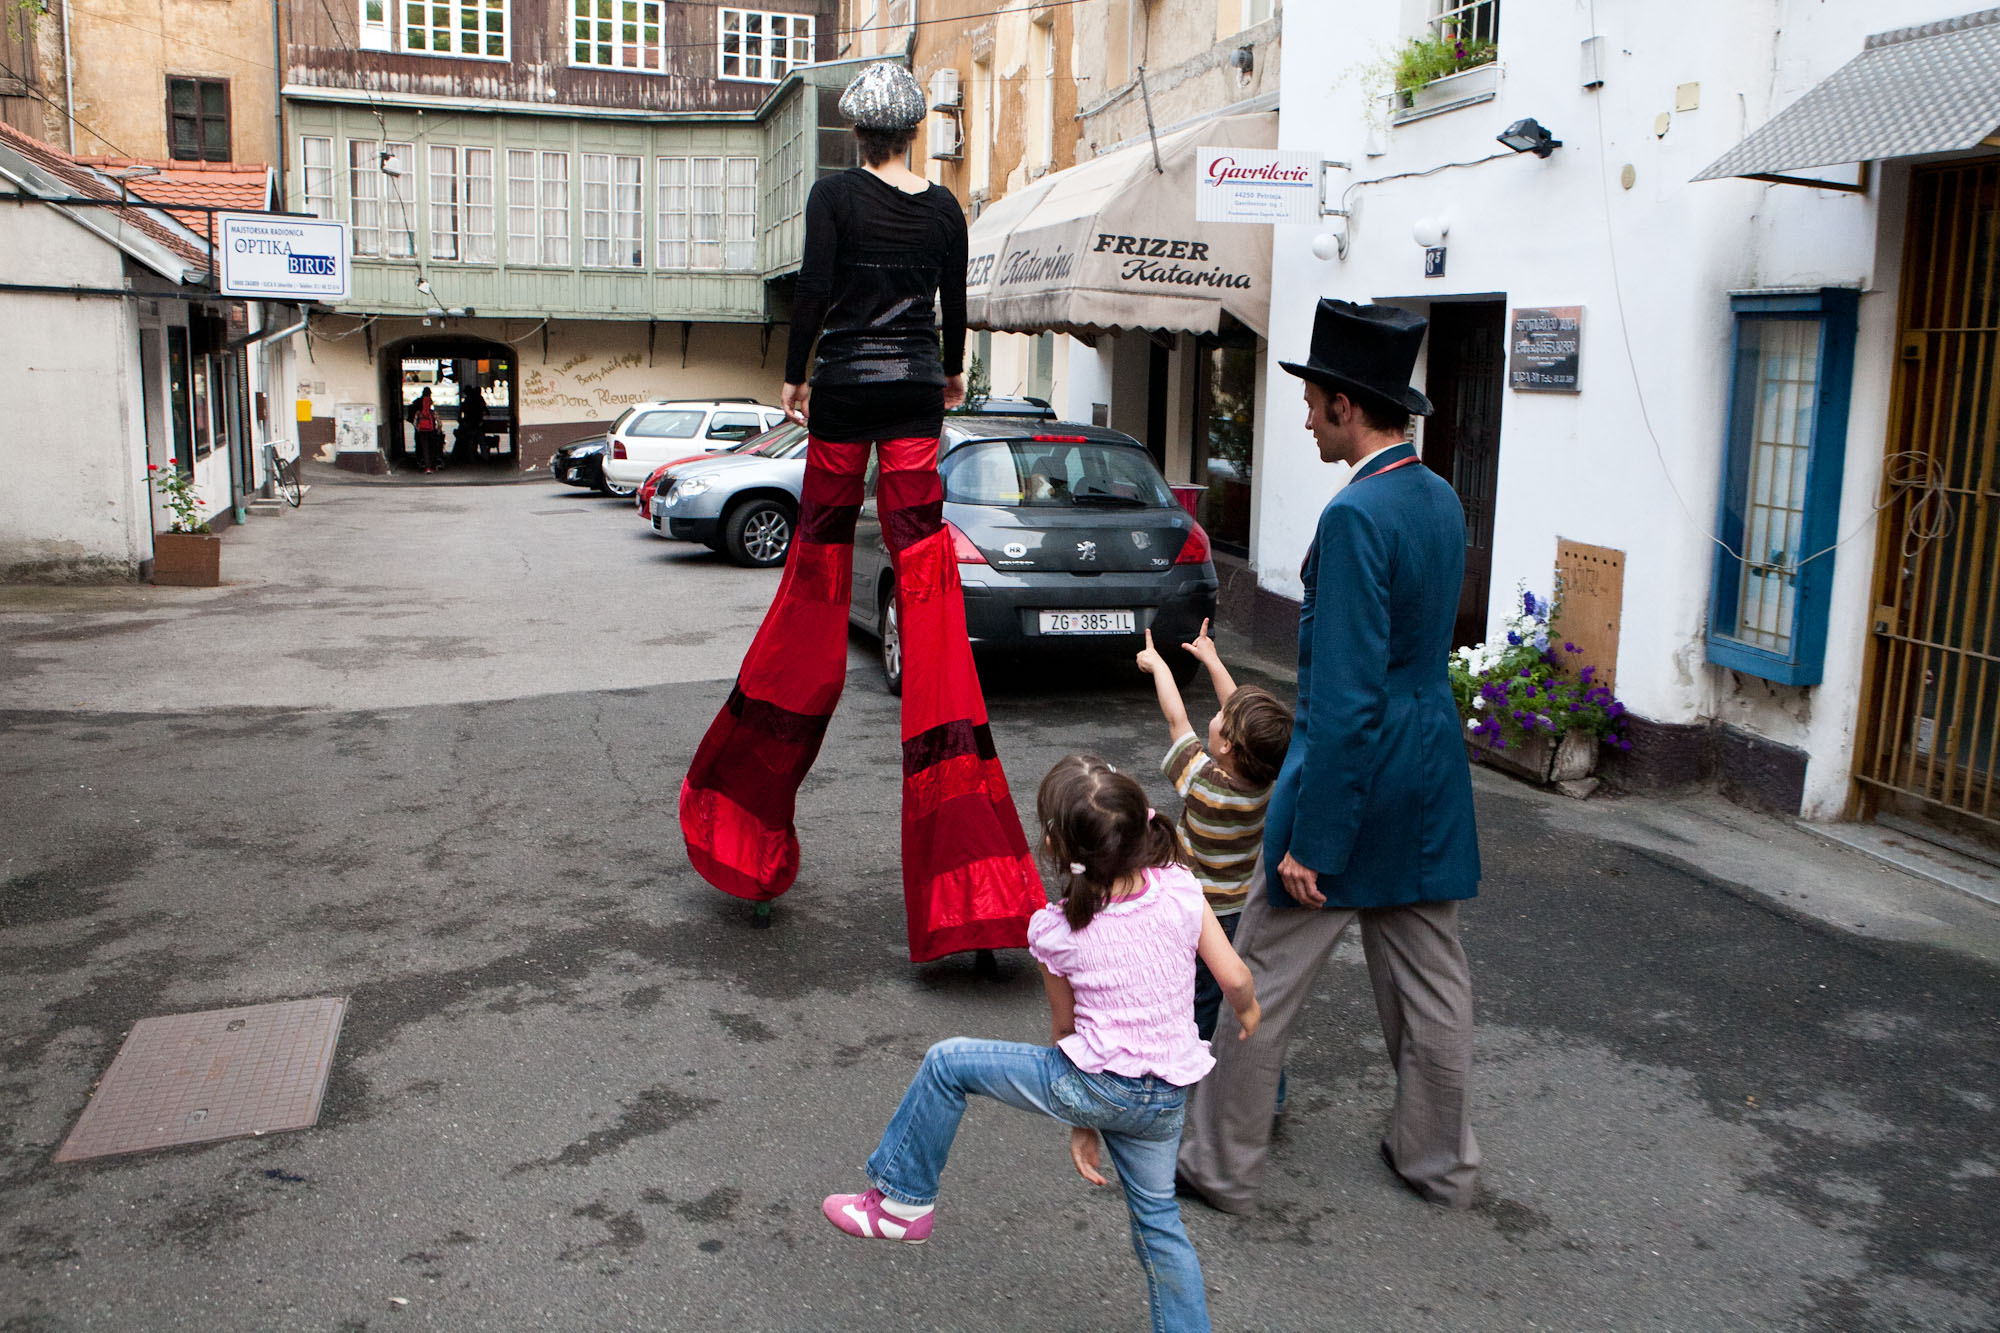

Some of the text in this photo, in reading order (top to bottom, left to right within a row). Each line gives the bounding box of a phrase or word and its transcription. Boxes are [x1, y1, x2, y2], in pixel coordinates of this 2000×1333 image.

[1208, 156, 1309, 187] Gavrilović
[230, 226, 304, 237] MAJSTORSKA RADIONICA
[234, 238, 293, 255] OPTIKA
[1093, 233, 1209, 261] FRIZER
[289, 255, 335, 274] BIRUŠ
[966, 244, 1075, 288] ZER Katarina
[1121, 258, 1252, 289] Katarina
[1051, 614, 1132, 630] ZG 385-IL
